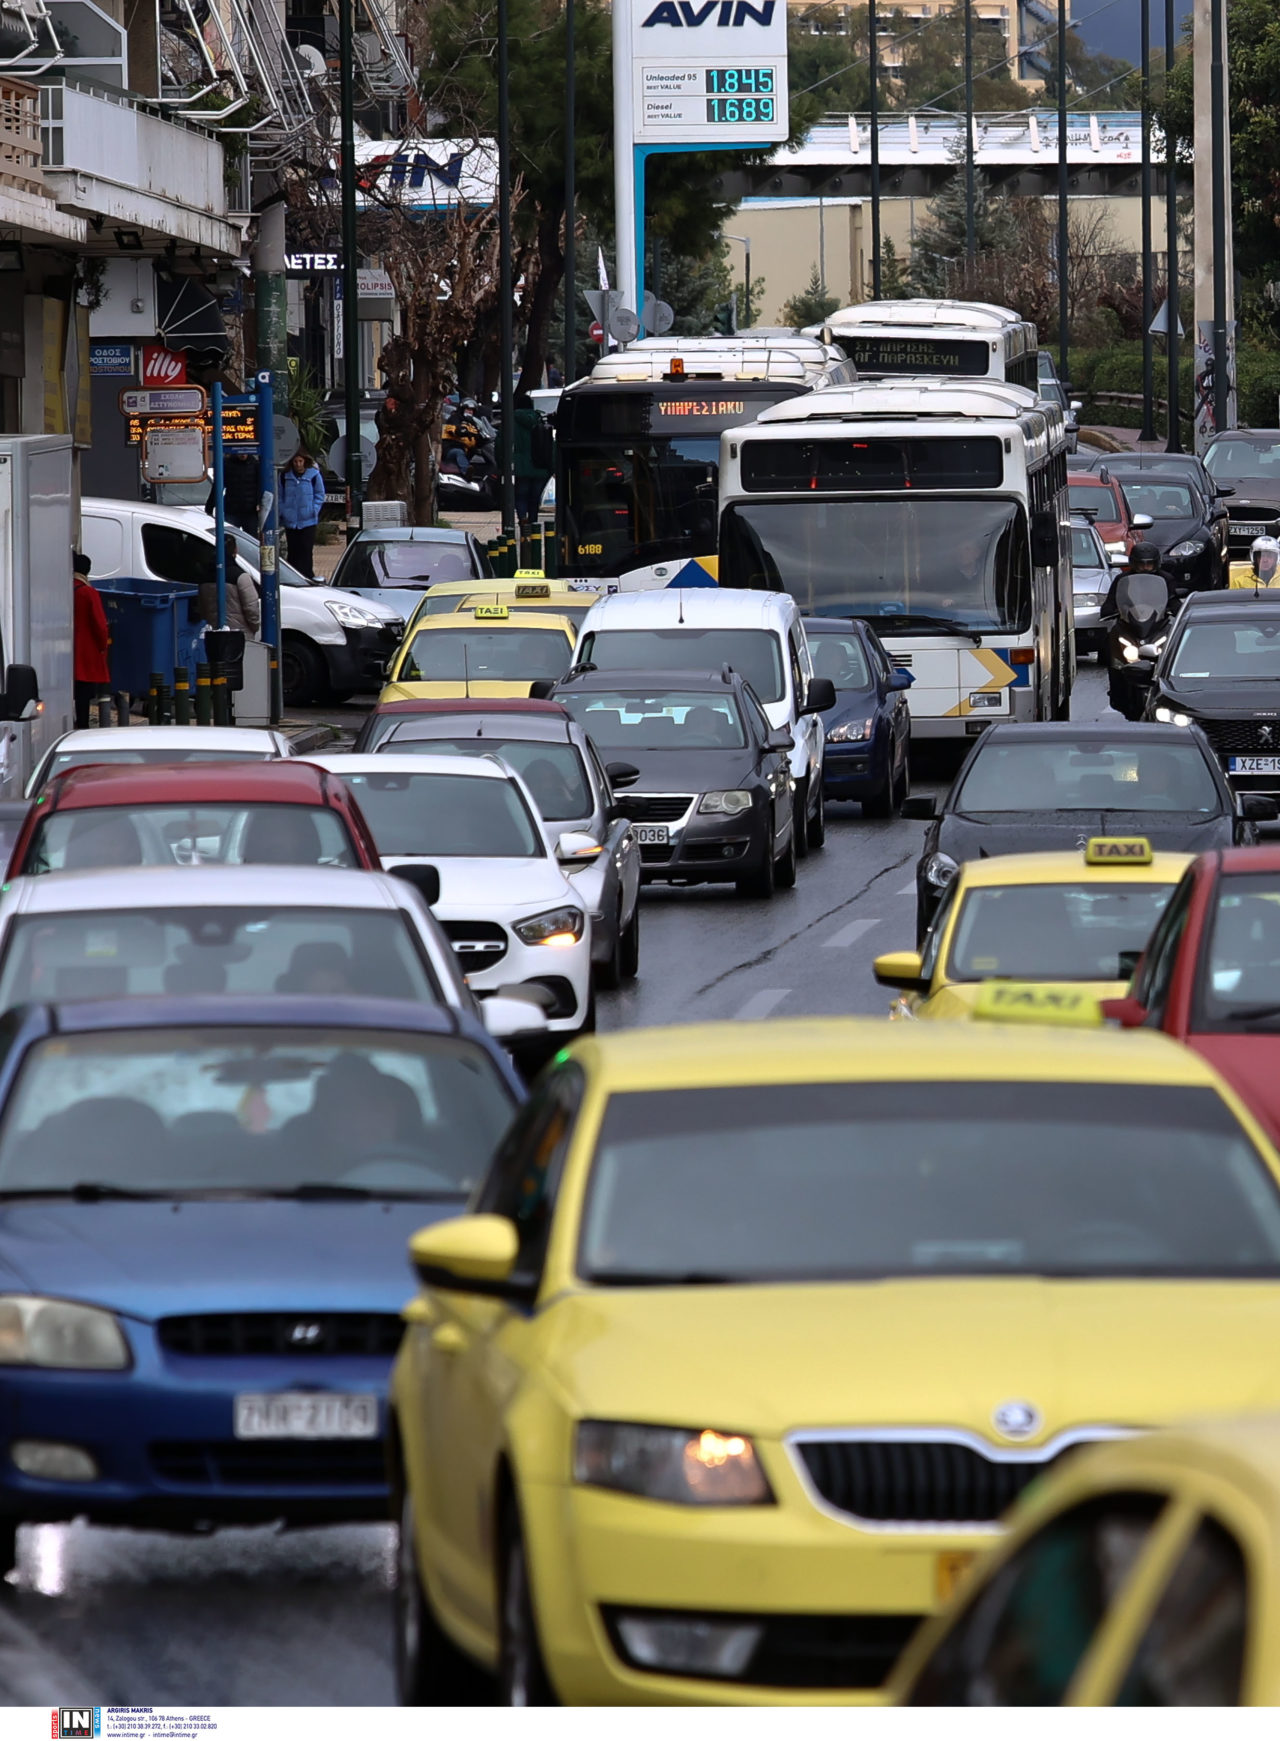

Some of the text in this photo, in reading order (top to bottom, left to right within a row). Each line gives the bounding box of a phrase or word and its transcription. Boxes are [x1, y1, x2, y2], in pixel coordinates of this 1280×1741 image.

[641, 1, 776, 27] AVIN
[646, 74, 686, 82] Unleaded
[710, 70, 772, 93] 1.845
[711, 98, 773, 122] 1.689
[95, 348, 121, 356] ΟΔΟΣ
[146, 352, 182, 383] illy
[578, 544, 602, 555] 6188
[517, 586, 548, 595] TAXI
[1093, 844, 1146, 857] TAXI
